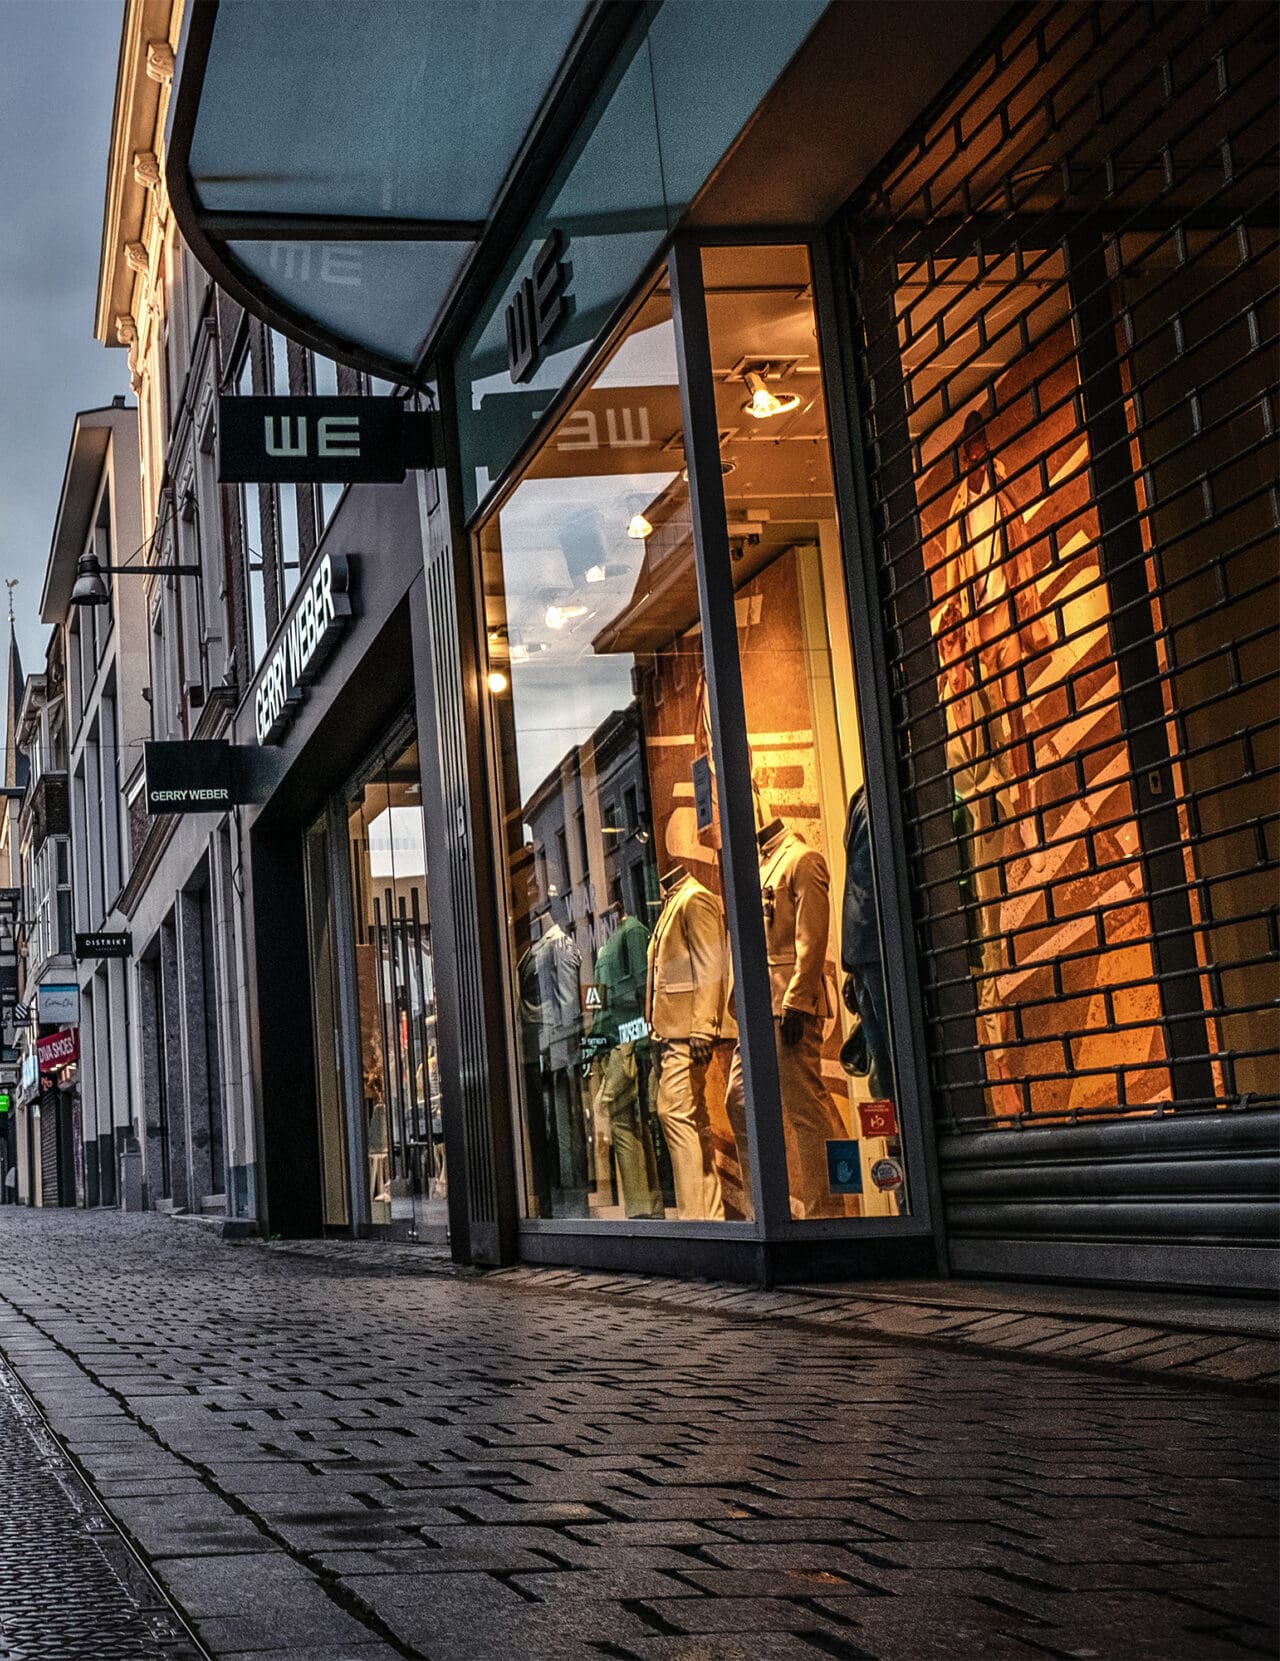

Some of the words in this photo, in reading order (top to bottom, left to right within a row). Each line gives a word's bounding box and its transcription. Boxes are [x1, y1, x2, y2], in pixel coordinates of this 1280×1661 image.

[505, 228, 563, 384] WE
[264, 416, 360, 457] WE
[255, 635, 288, 747] GERRY
[288, 553, 336, 688] WEBER
[150, 789, 188, 801] GERRY
[189, 788, 229, 800] WEBER
[85, 938, 126, 946] DISTRIKT
[53, 1037, 74, 1059] SHOES
